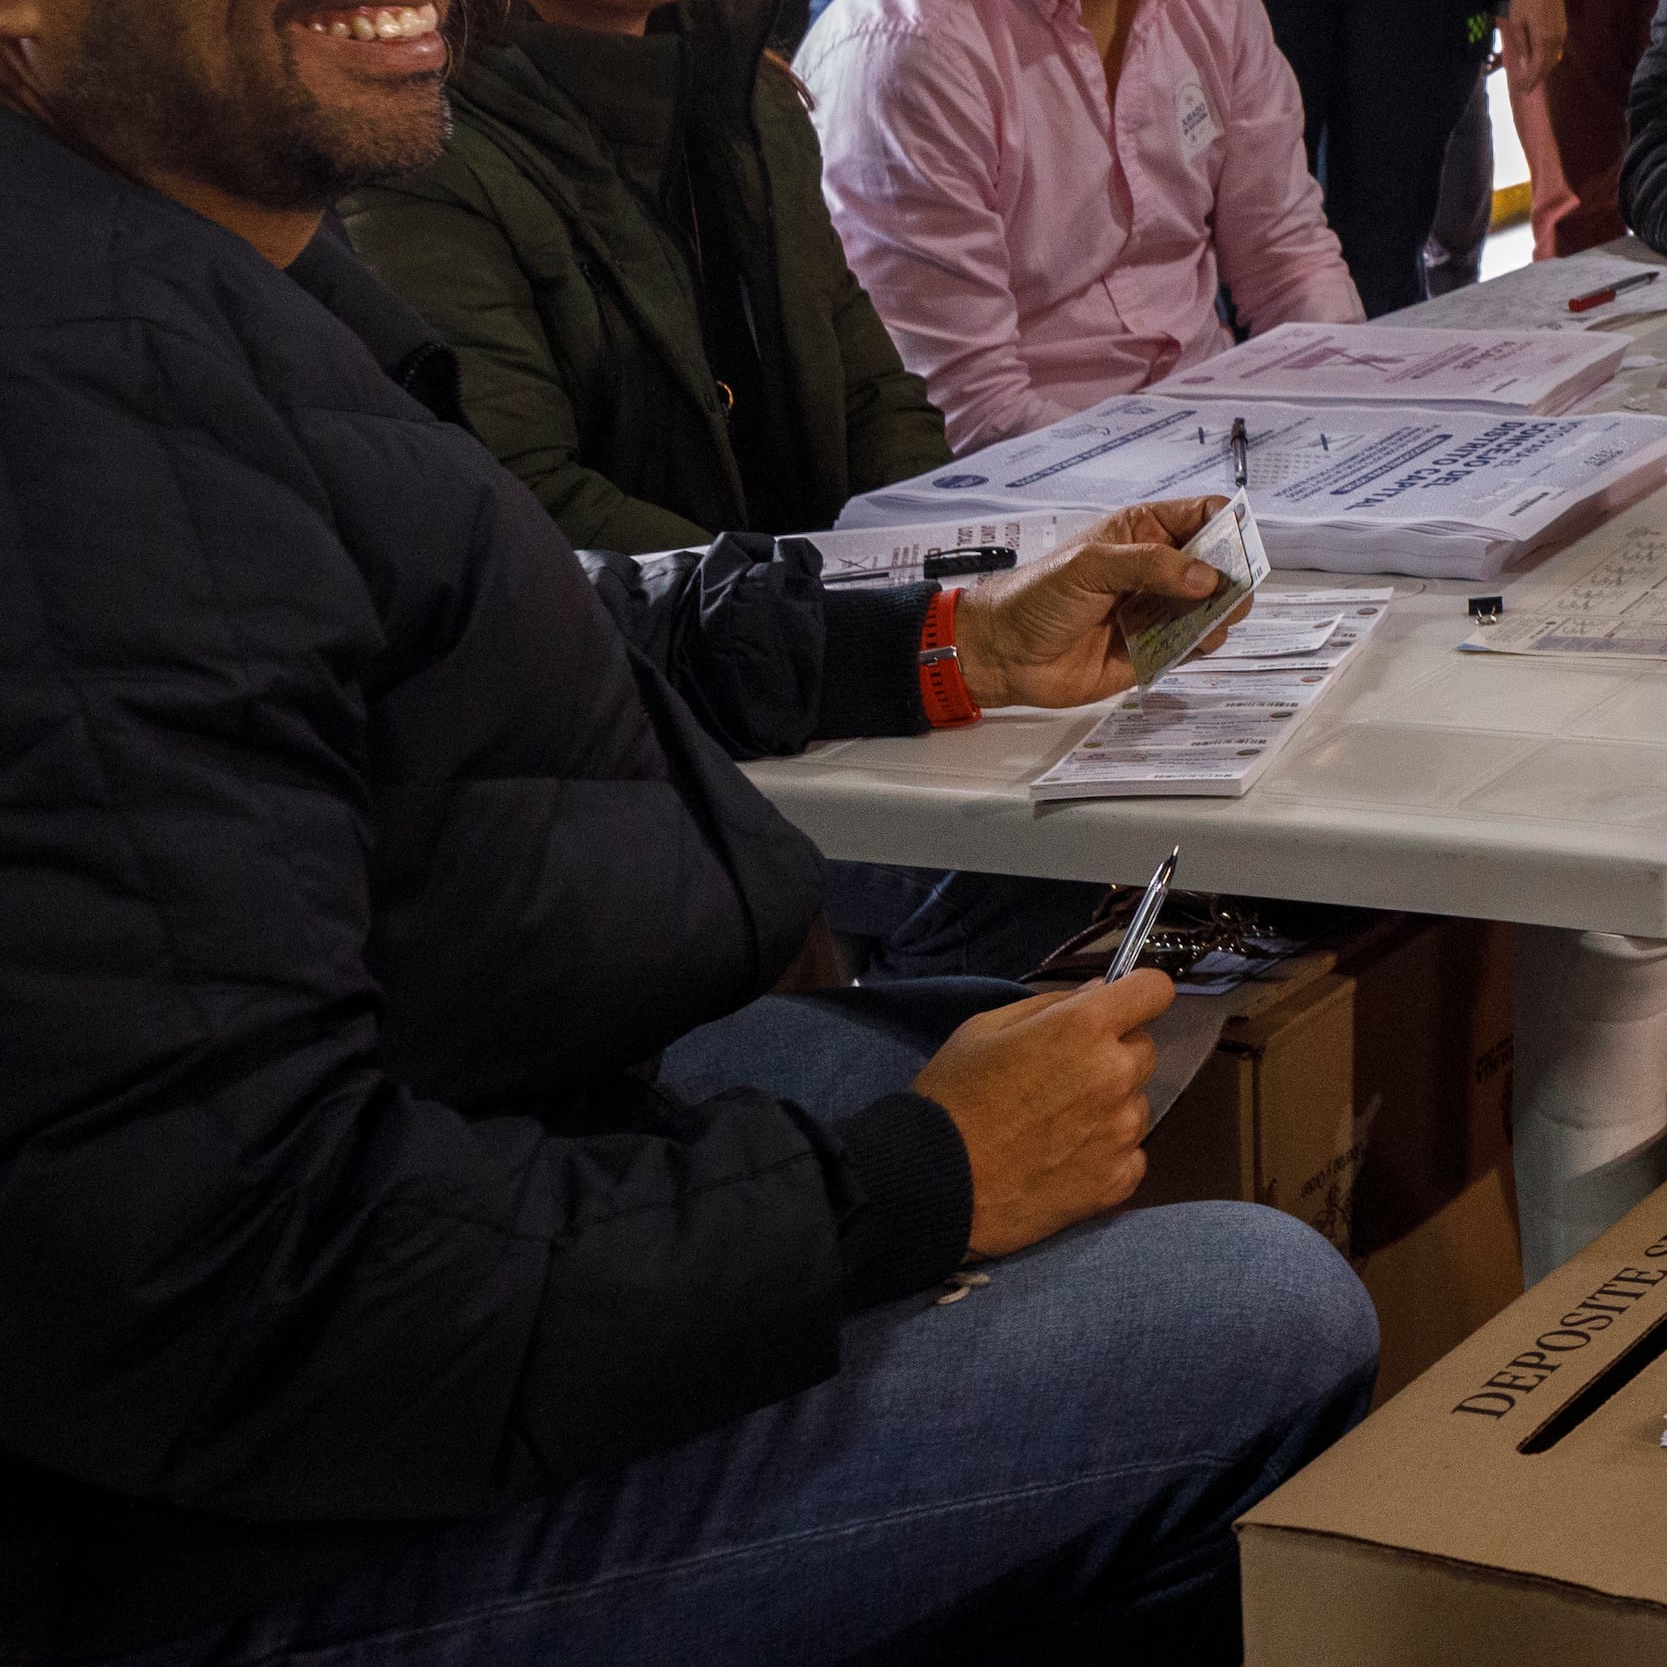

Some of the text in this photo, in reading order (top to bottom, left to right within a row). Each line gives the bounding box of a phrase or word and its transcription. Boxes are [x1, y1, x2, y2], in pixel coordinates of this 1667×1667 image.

[1432, 421, 1527, 466] DISTRITO
[1463, 422, 1557, 468] CONCEJO
[1343, 468, 1441, 511] CAPITAL
[1421, 470, 1474, 489] DEL
